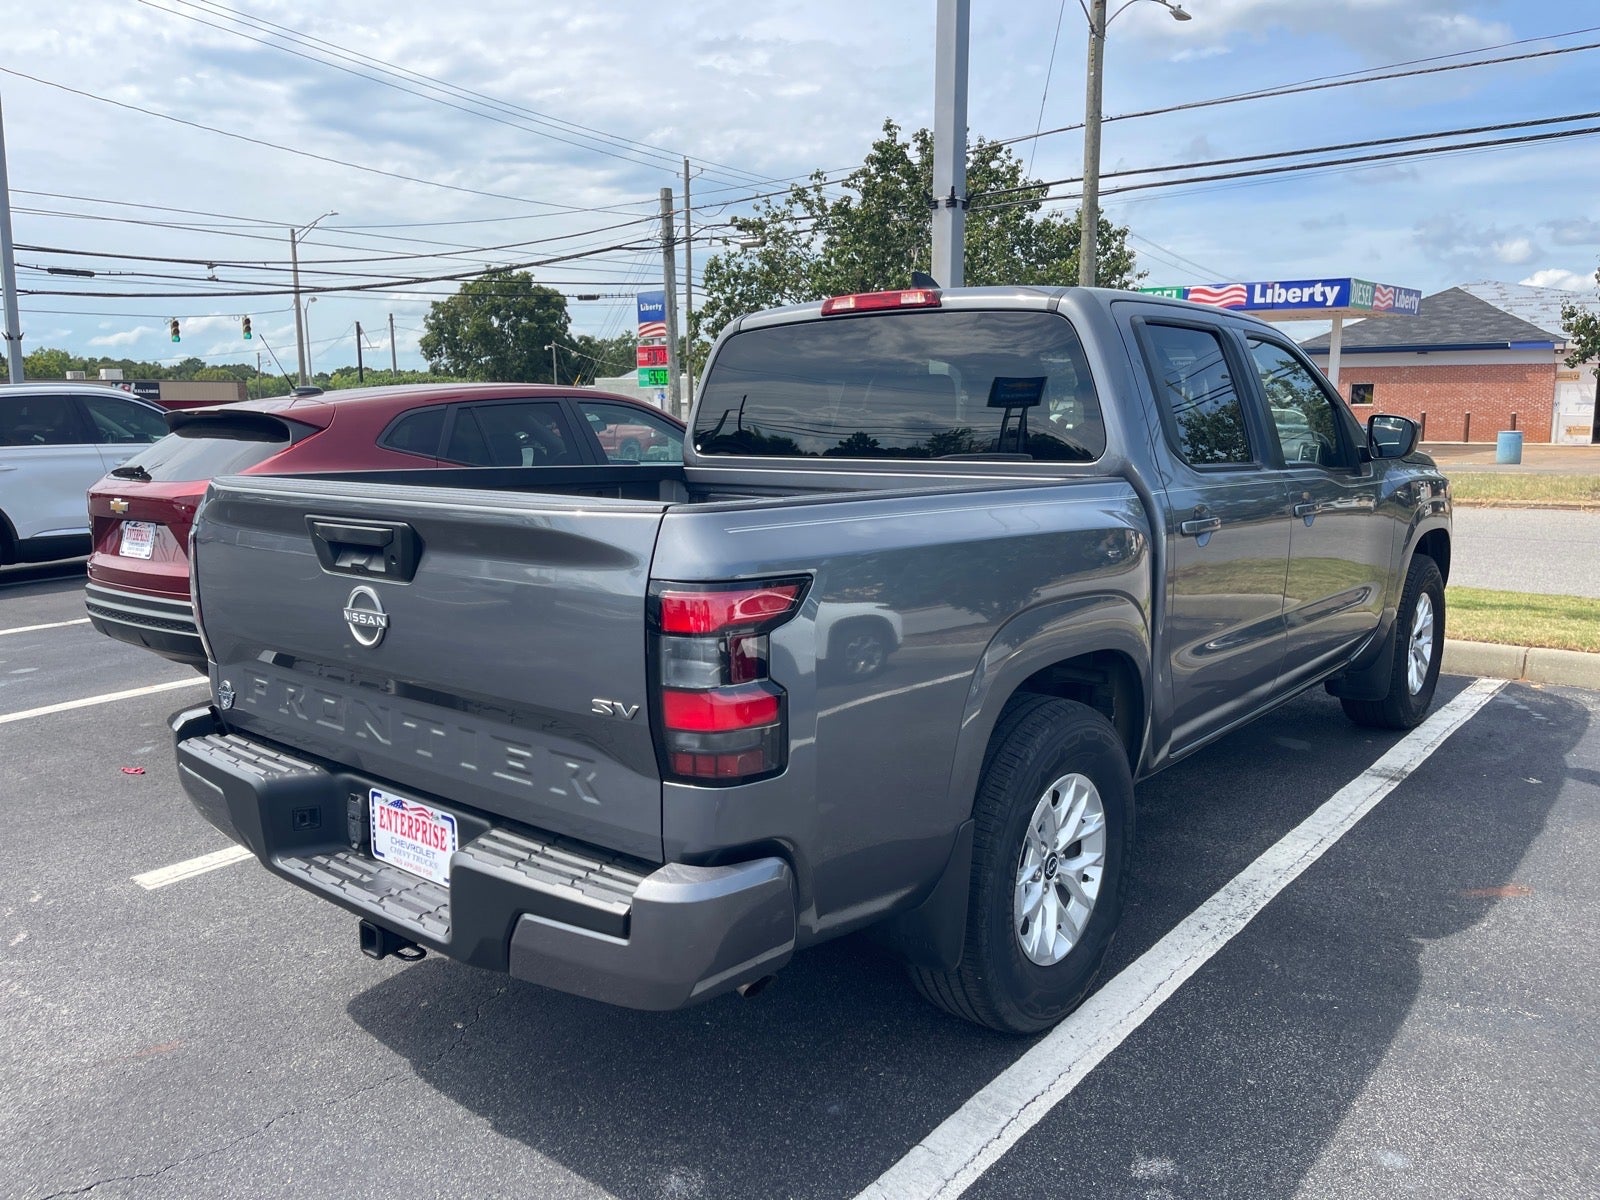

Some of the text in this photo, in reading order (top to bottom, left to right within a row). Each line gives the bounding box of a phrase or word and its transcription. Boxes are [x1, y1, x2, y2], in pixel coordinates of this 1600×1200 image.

[1253, 282, 1341, 307] Liberty
[1351, 280, 1372, 306] DIESEL
[1394, 288, 1420, 315] Liberty
[640, 303, 663, 312] Liberty
[343, 610, 386, 627] NISSAN
[591, 698, 640, 721] SV
[242, 668, 601, 806] FRONTIER
[379, 805, 447, 852] ENTERPRISE
[390, 836, 436, 860] CHEVROLET
